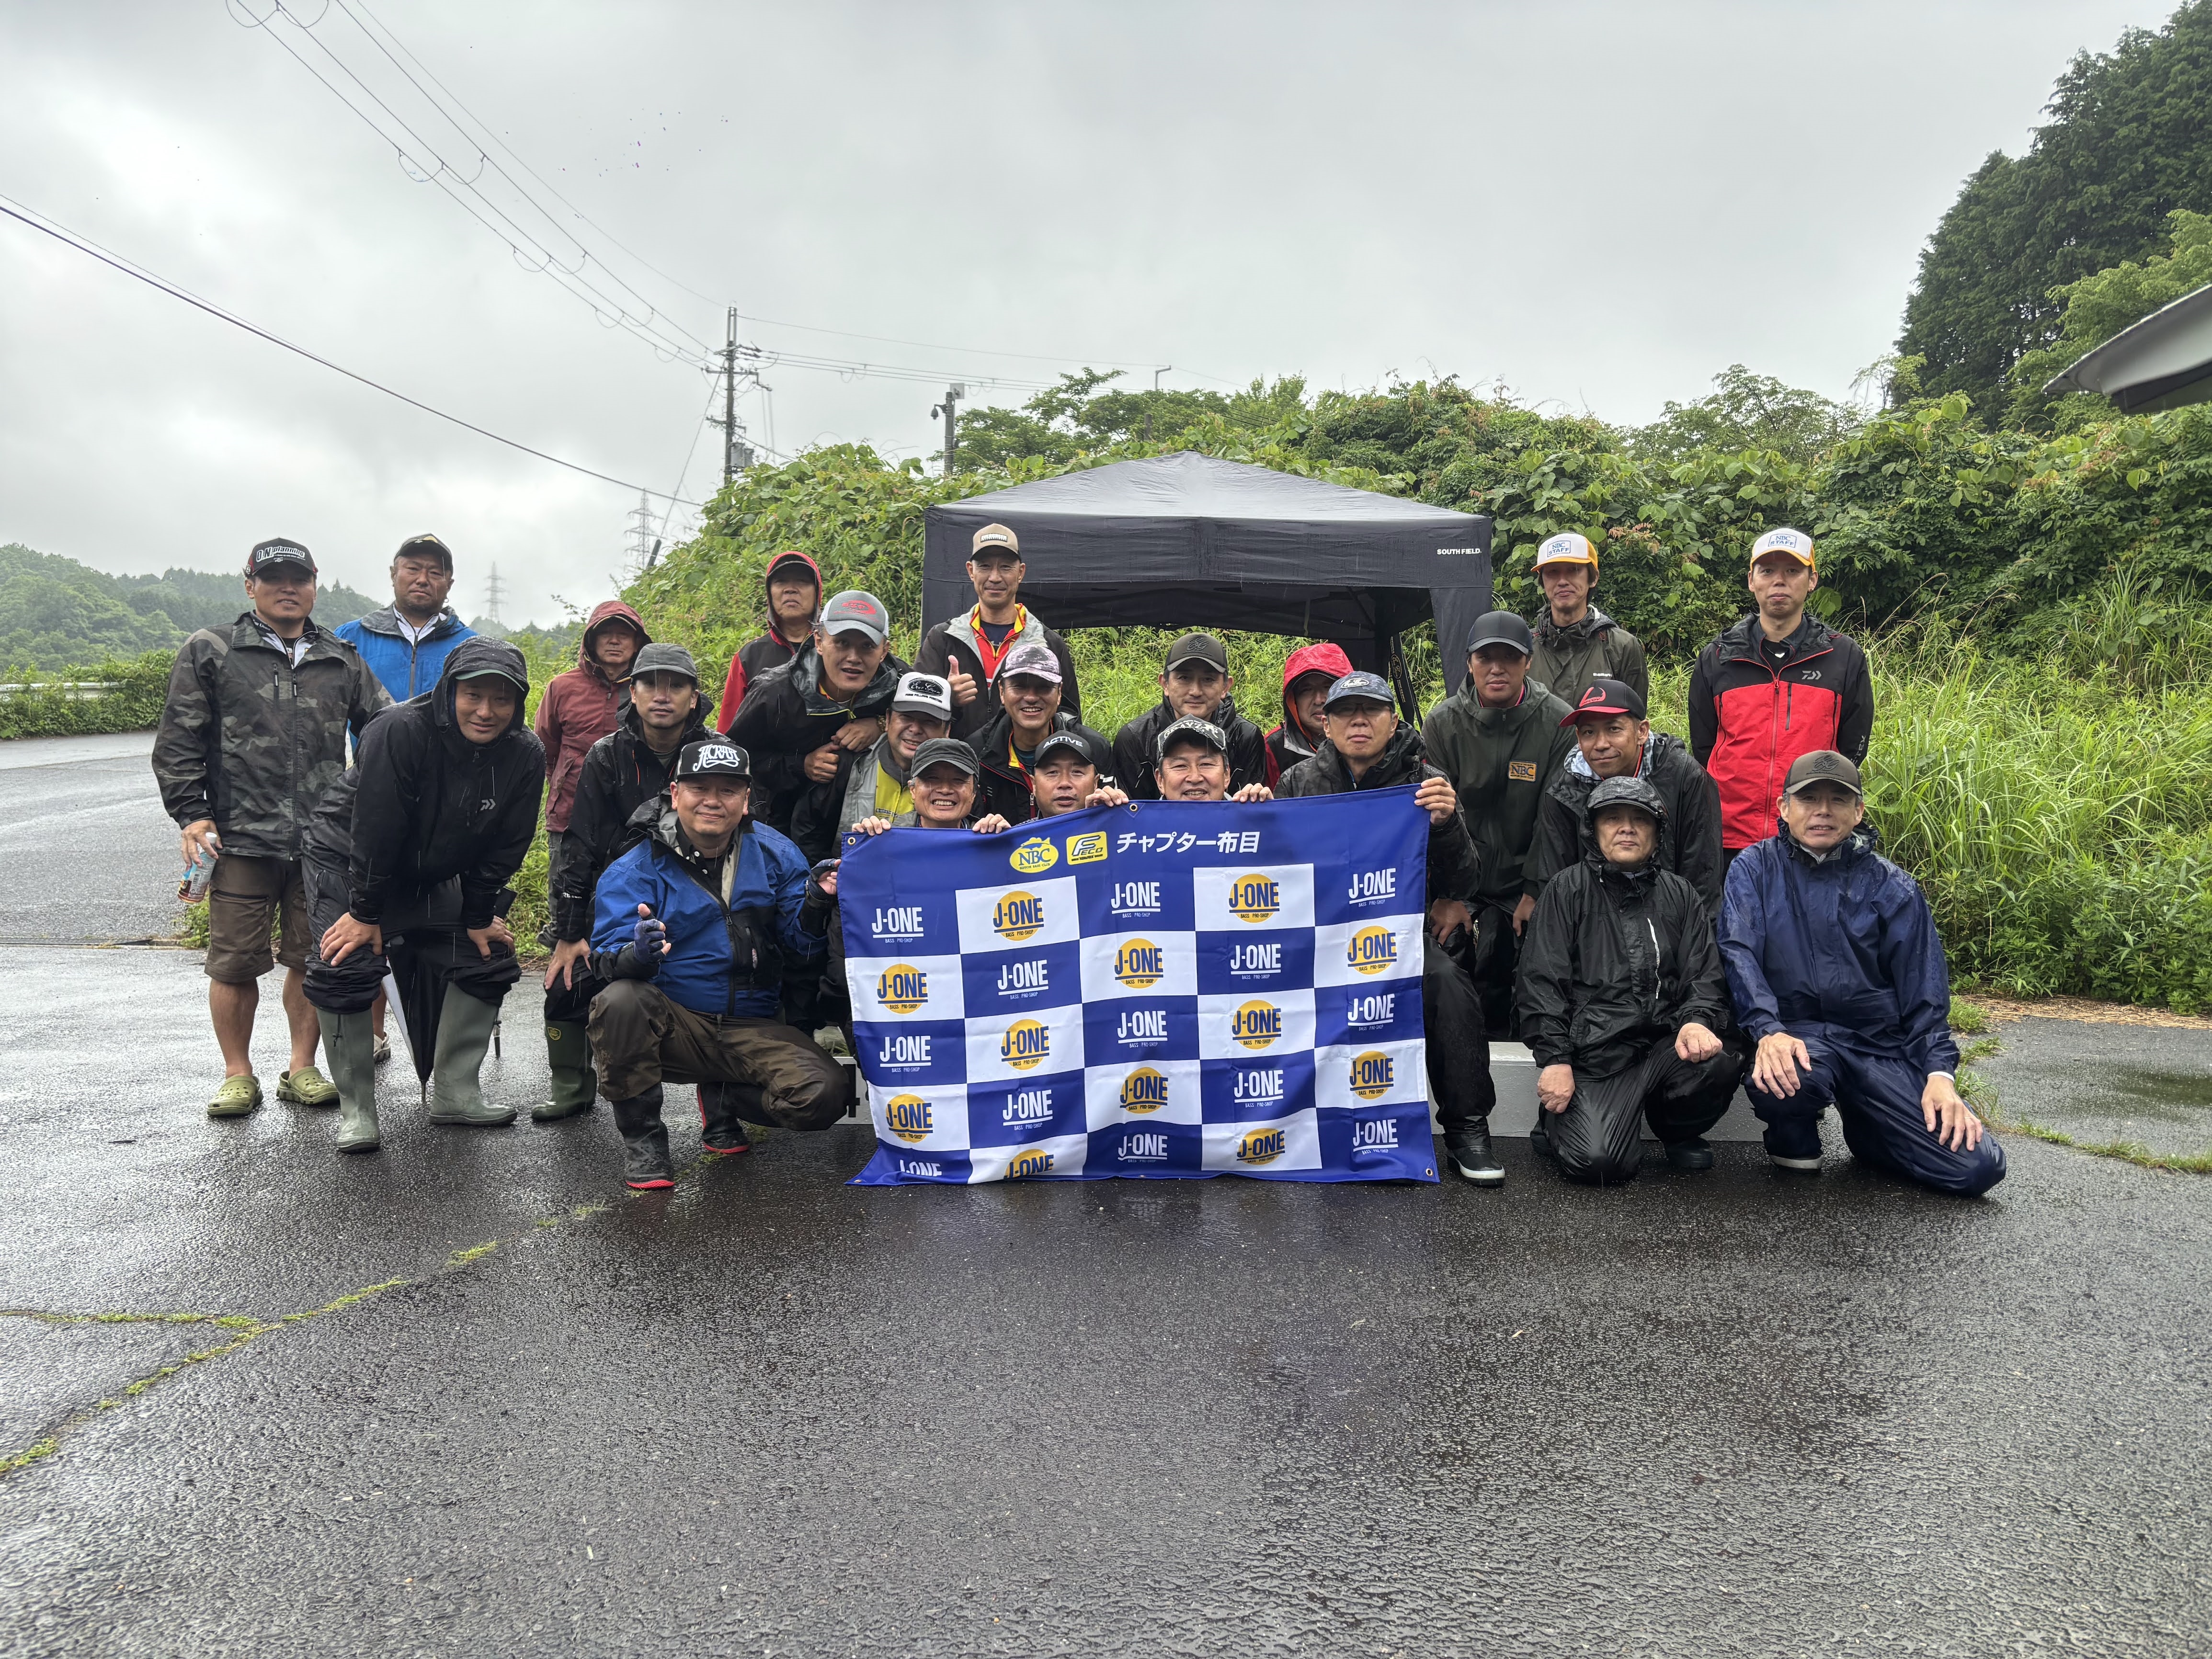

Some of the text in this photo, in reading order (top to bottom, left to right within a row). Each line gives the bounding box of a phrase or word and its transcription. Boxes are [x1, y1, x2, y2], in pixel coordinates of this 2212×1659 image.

[1043, 736, 1083, 749] ACTIVE
[1510, 765, 1534, 776] NBC
[1117, 831, 1260, 853] チャプター布目
[1018, 848, 1051, 866] NBC
[1111, 882, 1160, 909] J-ONE
[1229, 882, 1279, 908] J-ONE
[1349, 868, 1396, 898] J-ONE
[872, 907, 924, 933] J-ONE
[993, 898, 1043, 928] J-ONE
[1230, 943, 1281, 969] J-ONE
[1348, 932, 1397, 962] J-ONE
[997, 960, 1048, 990] J-ONE
[1115, 948, 1163, 975] J-ONE
[878, 973, 927, 999] J-ONE
[1348, 993, 1395, 1021] J-ONE
[1117, 1011, 1167, 1038] J-ONE
[1232, 1008, 1281, 1035] J-ONE
[879, 1035, 931, 1062] J-ONE
[1001, 1026, 1049, 1057] J-ONE
[1234, 1070, 1284, 1098] J-ONE
[1350, 1057, 1393, 1086] J-ONE
[1120, 1076, 1168, 1103] J-ONE
[886, 1102, 933, 1128] J-ONE
[1003, 1089, 1053, 1120] J-ONE
[1118, 1133, 1168, 1157] J-ONE
[1237, 1130, 1285, 1158] J-ONE
[1353, 1119, 1398, 1146] J-ONE
